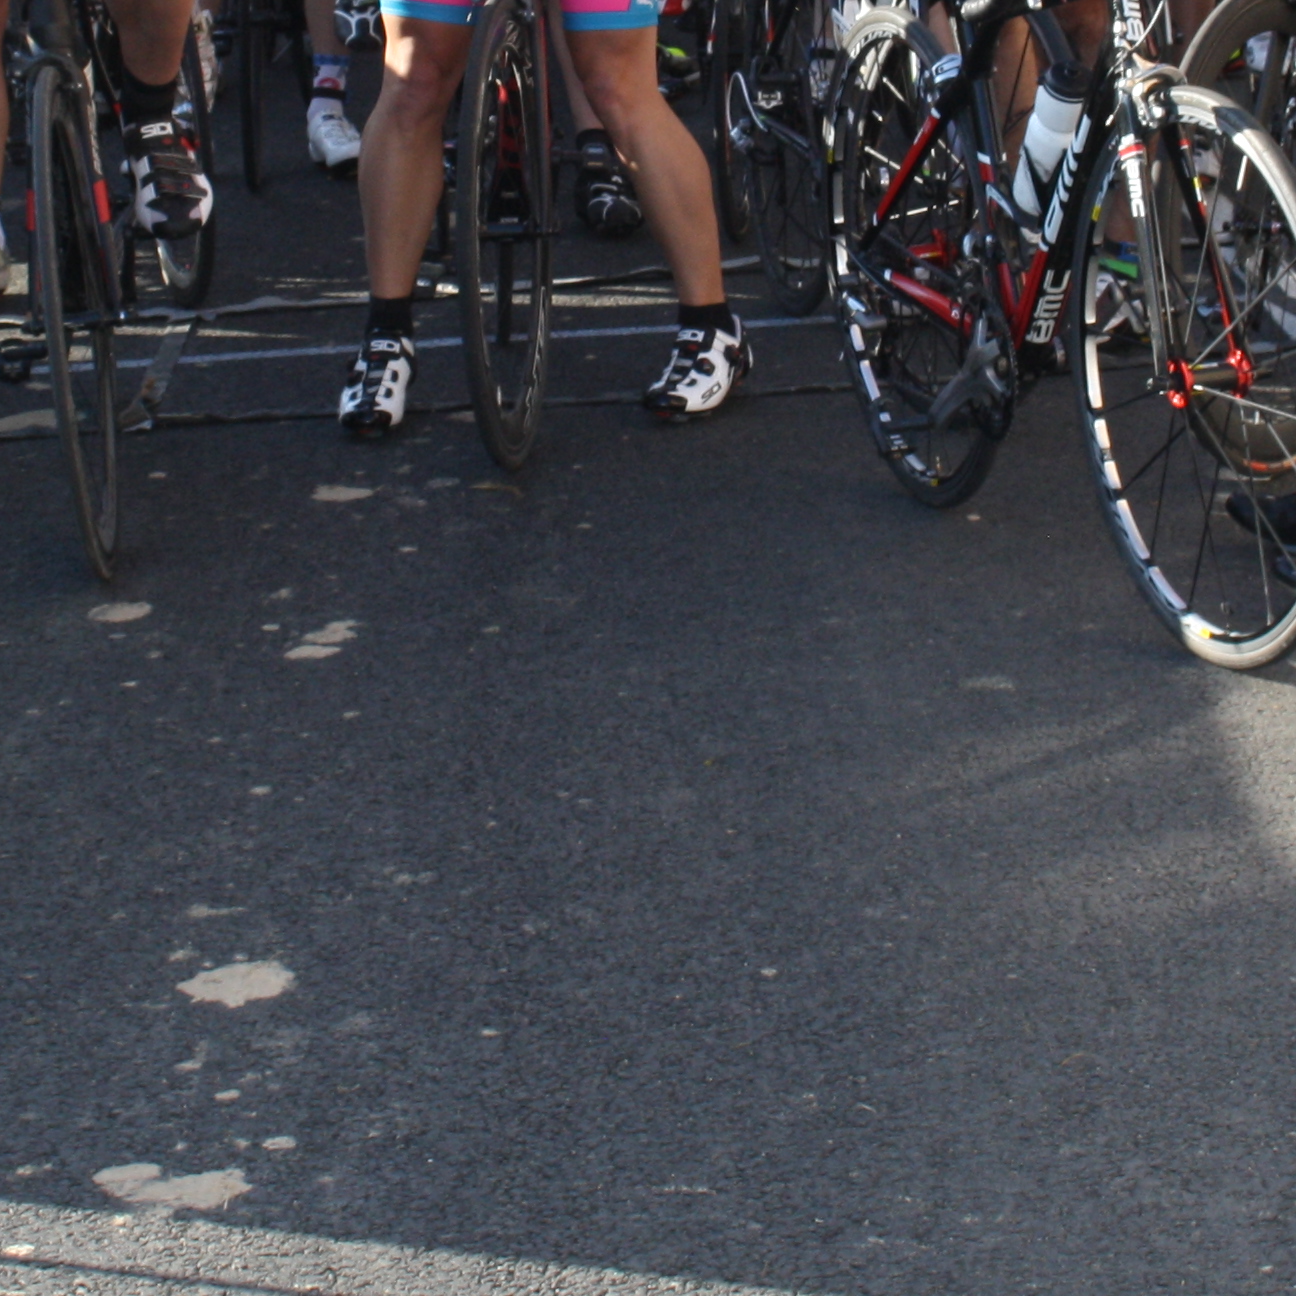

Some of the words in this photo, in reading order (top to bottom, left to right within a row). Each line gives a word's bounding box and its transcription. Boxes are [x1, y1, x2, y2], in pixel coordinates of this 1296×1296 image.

[140, 121, 173, 139] SIDI
[1124, 158, 1146, 218] BMC
[1025, 269, 1071, 344] BMC
[676, 329, 705, 342] SIDI
[370, 339, 401, 354] SIDI
